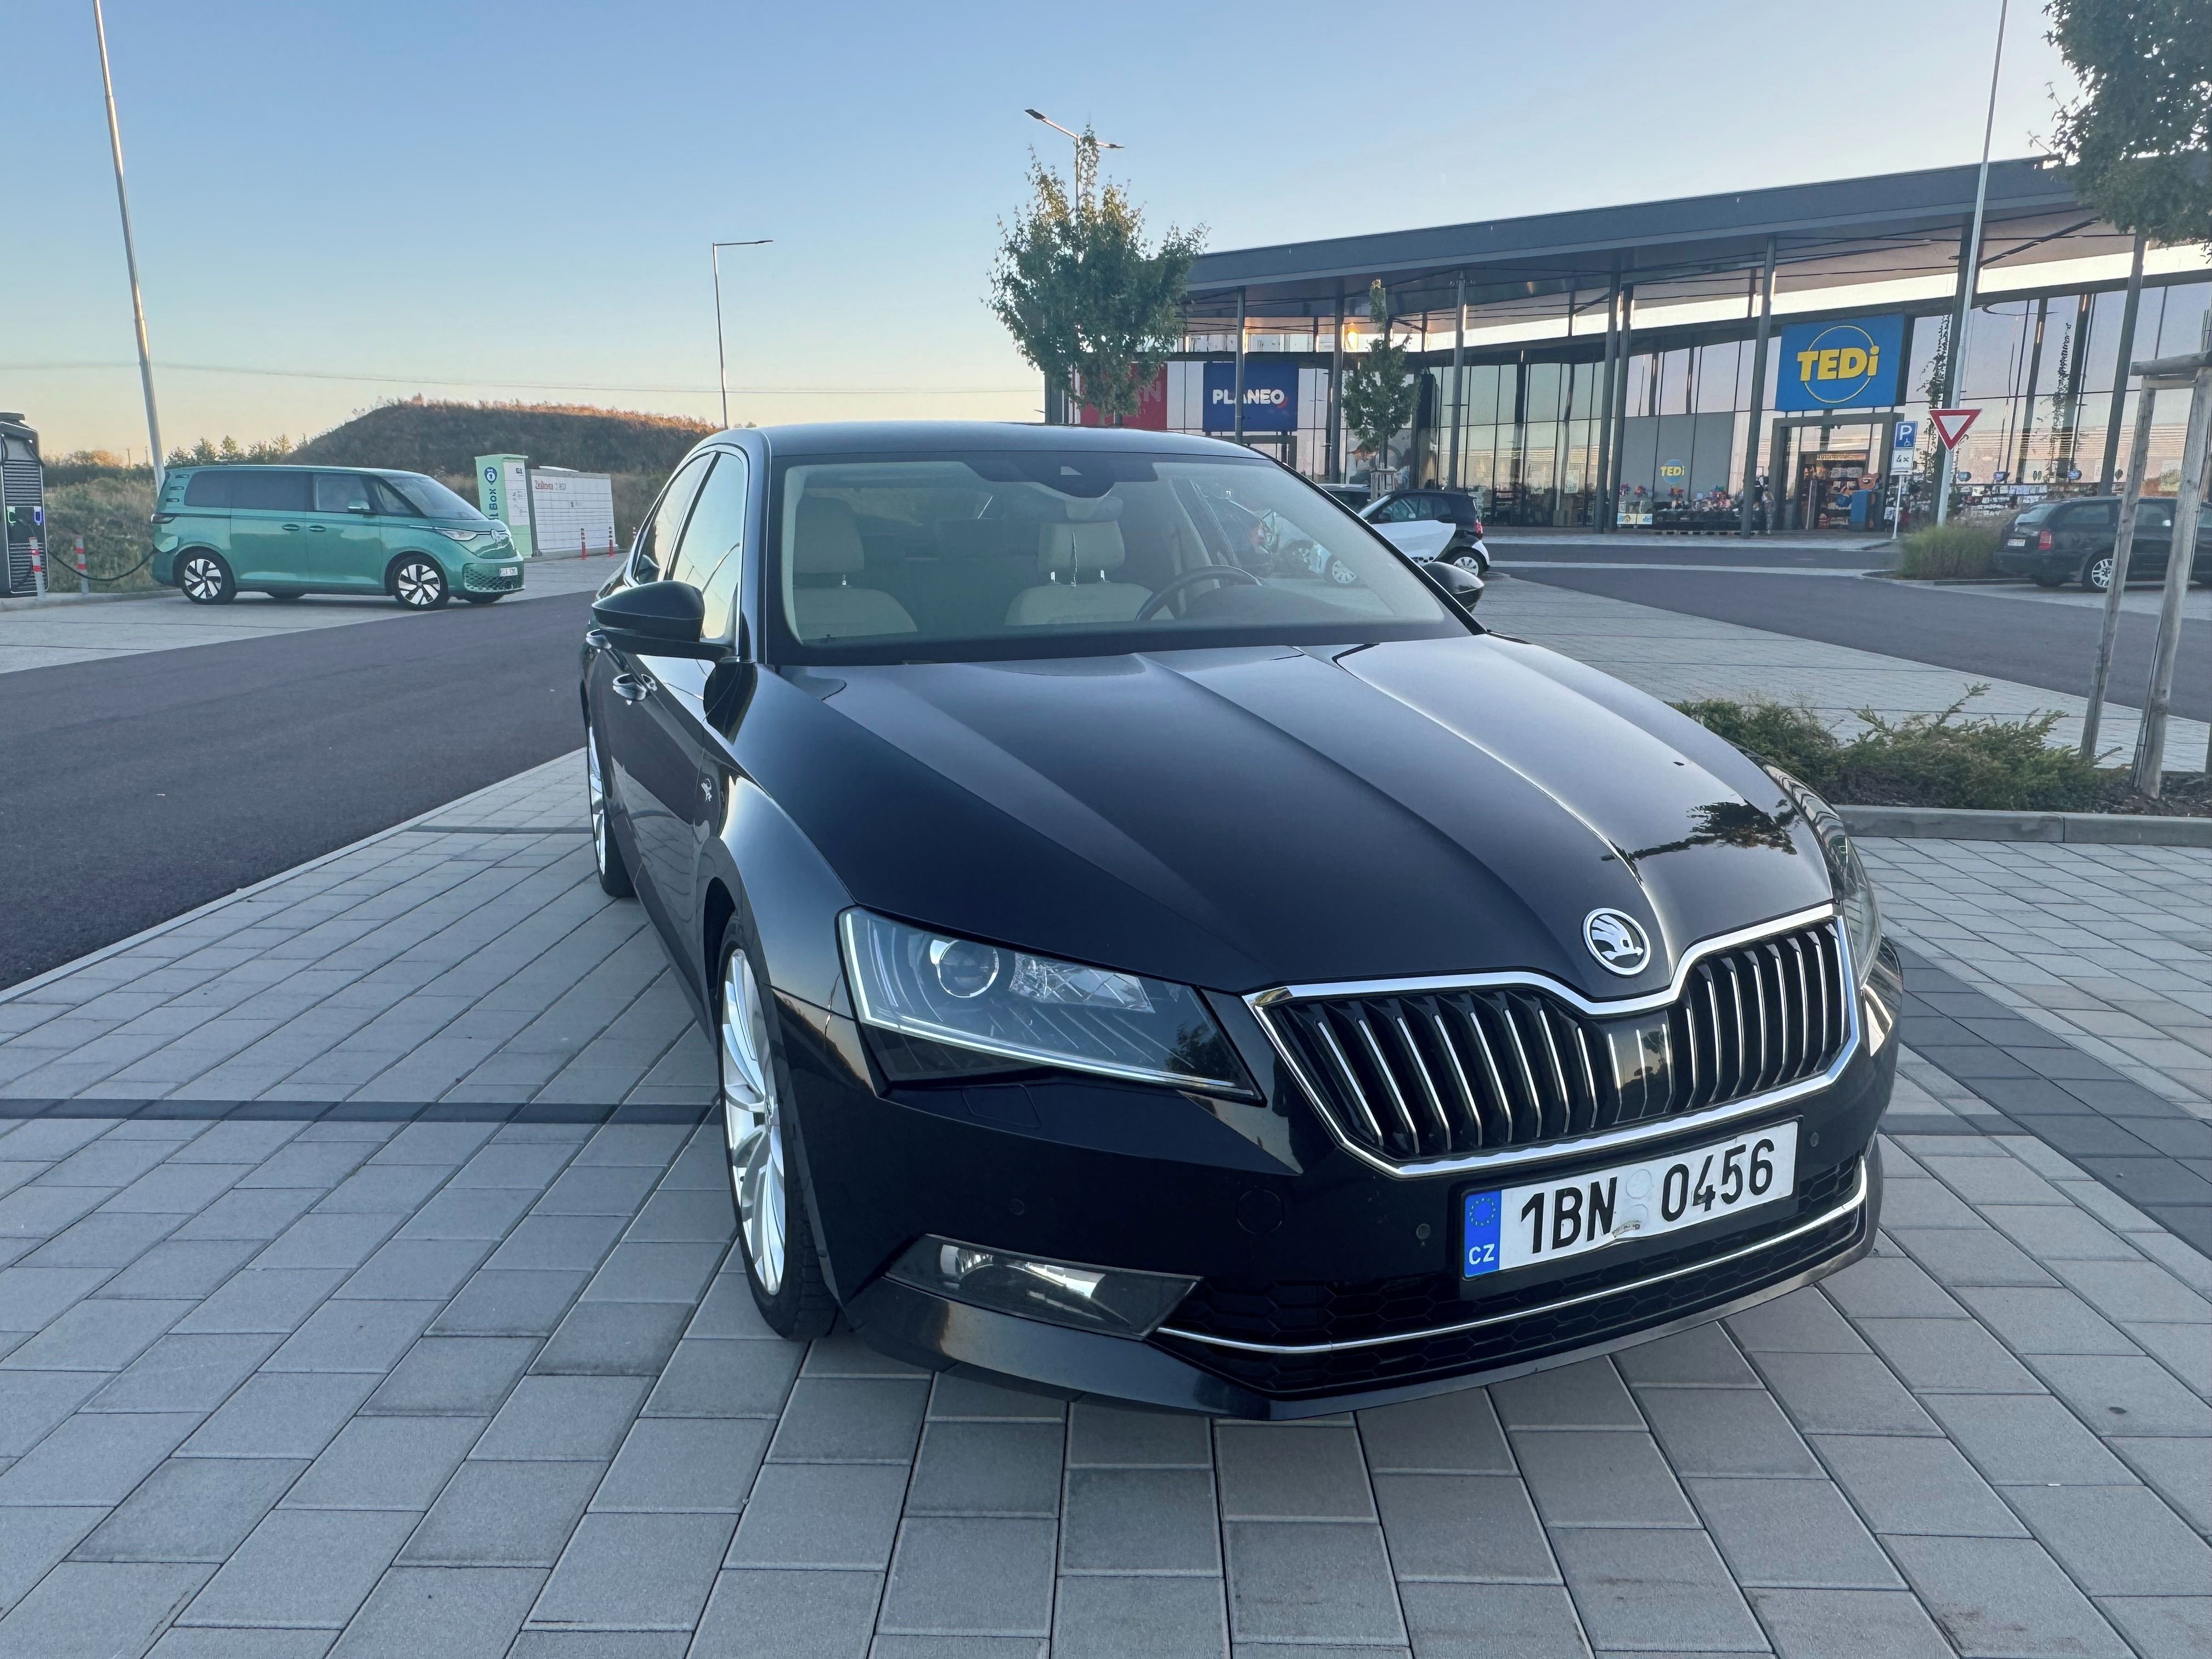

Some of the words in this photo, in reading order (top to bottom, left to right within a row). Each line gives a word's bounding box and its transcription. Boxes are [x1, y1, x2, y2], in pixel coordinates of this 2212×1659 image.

[1797, 346, 1880, 381] TEDi
[1899, 425, 1912, 441] P
[1896, 454, 1910, 462] 4x
[1660, 466, 1685, 476] TEDi
[1520, 1176, 1618, 1254] 1BN
[1661, 1138, 1775, 1222] 0456
[1469, 1243, 1495, 1265] CZ
